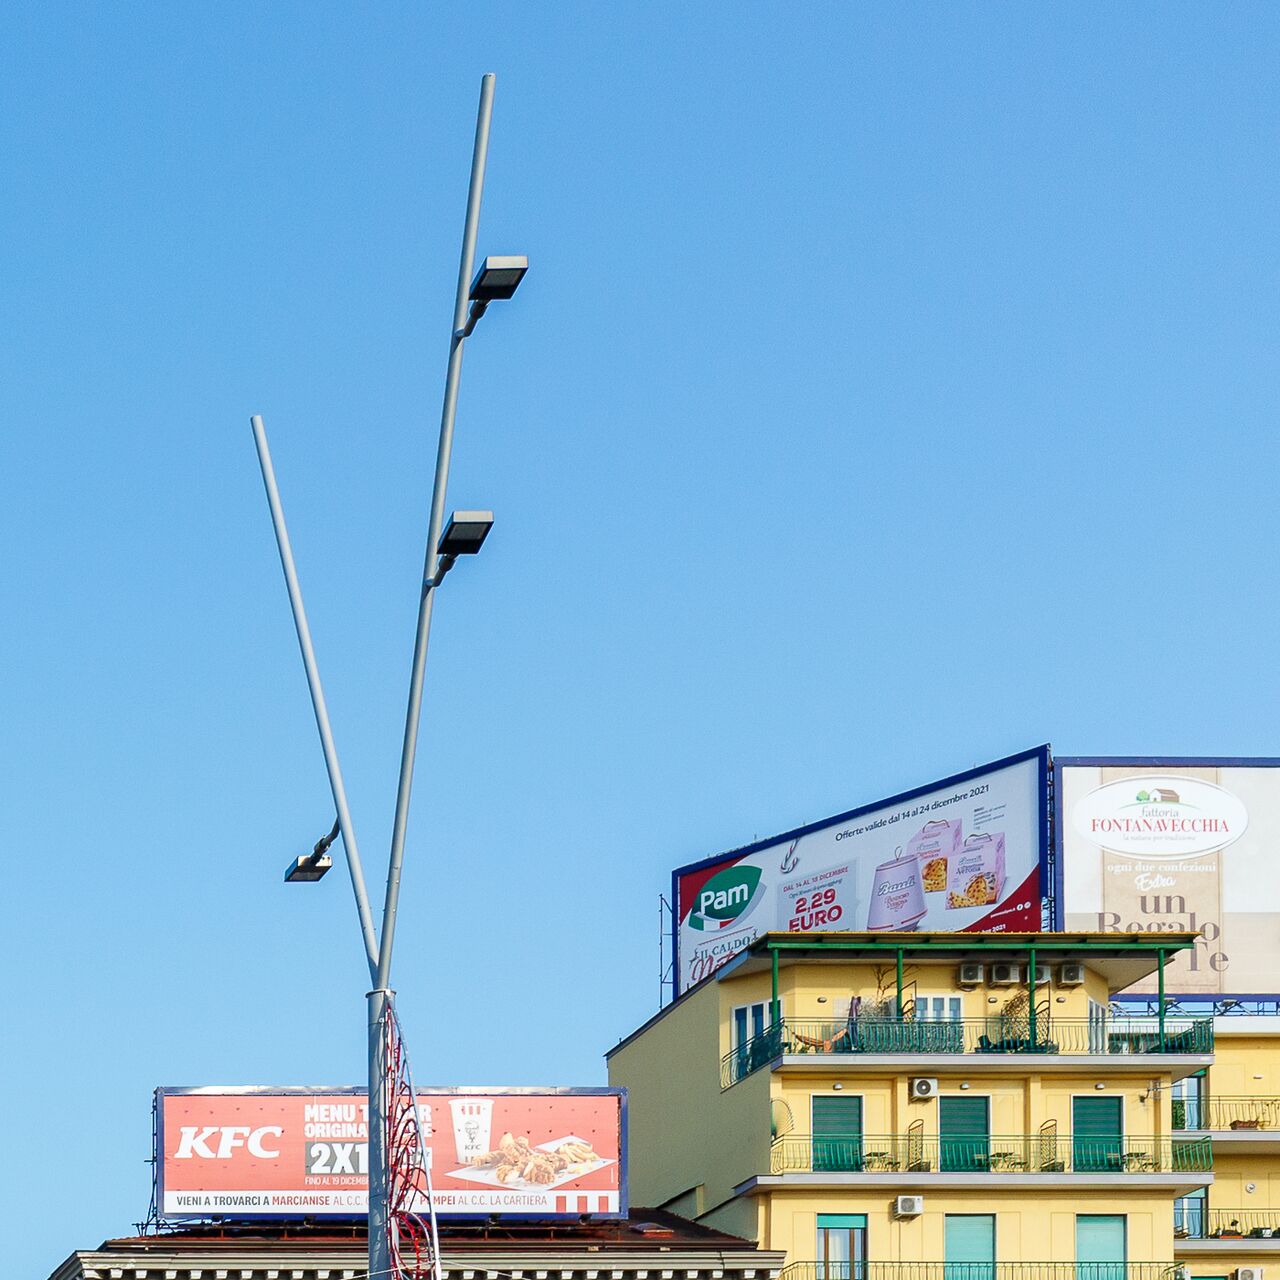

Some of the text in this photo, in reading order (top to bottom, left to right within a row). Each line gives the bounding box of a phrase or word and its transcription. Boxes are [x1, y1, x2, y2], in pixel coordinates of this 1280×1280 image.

[835, 784, 990, 842] Offerte valide dal 14 al 24 dicembre 2021
[1141, 806, 1180, 818] fattoria
[1091, 819, 1229, 833] FONTANAVECCHIA
[1107, 861, 1217, 874] ogni due confezioni
[700, 883, 749, 915] Pam
[795, 888, 836, 914] 2,29
[1140, 894, 1187, 914] un
[788, 905, 843, 932] EURO
[711, 934, 751, 956] CALDO
[304, 1104, 356, 1122] MENU
[304, 1123, 369, 1138] ORIGINA
[173, 1126, 282, 1159] KFC
[304, 1176, 369, 1185] FINO AL 19 DICEMB
[176, 1195, 202, 1206] VIENI
[204, 1195, 211, 1206] A
[213, 1195, 261, 1206] TROVARCI
[263, 1195, 270, 1206] A
[272, 1195, 330, 1206] MARCIANISE
[333, 1195, 343, 1206] AL
[346, 1195, 363, 1206] C.C.
[458, 1195, 469, 1205] AL
[471, 1195, 488, 1205] C.C.
[490, 1195, 502, 1205] LA
[503, 1195, 548, 1205] CARTIERA
